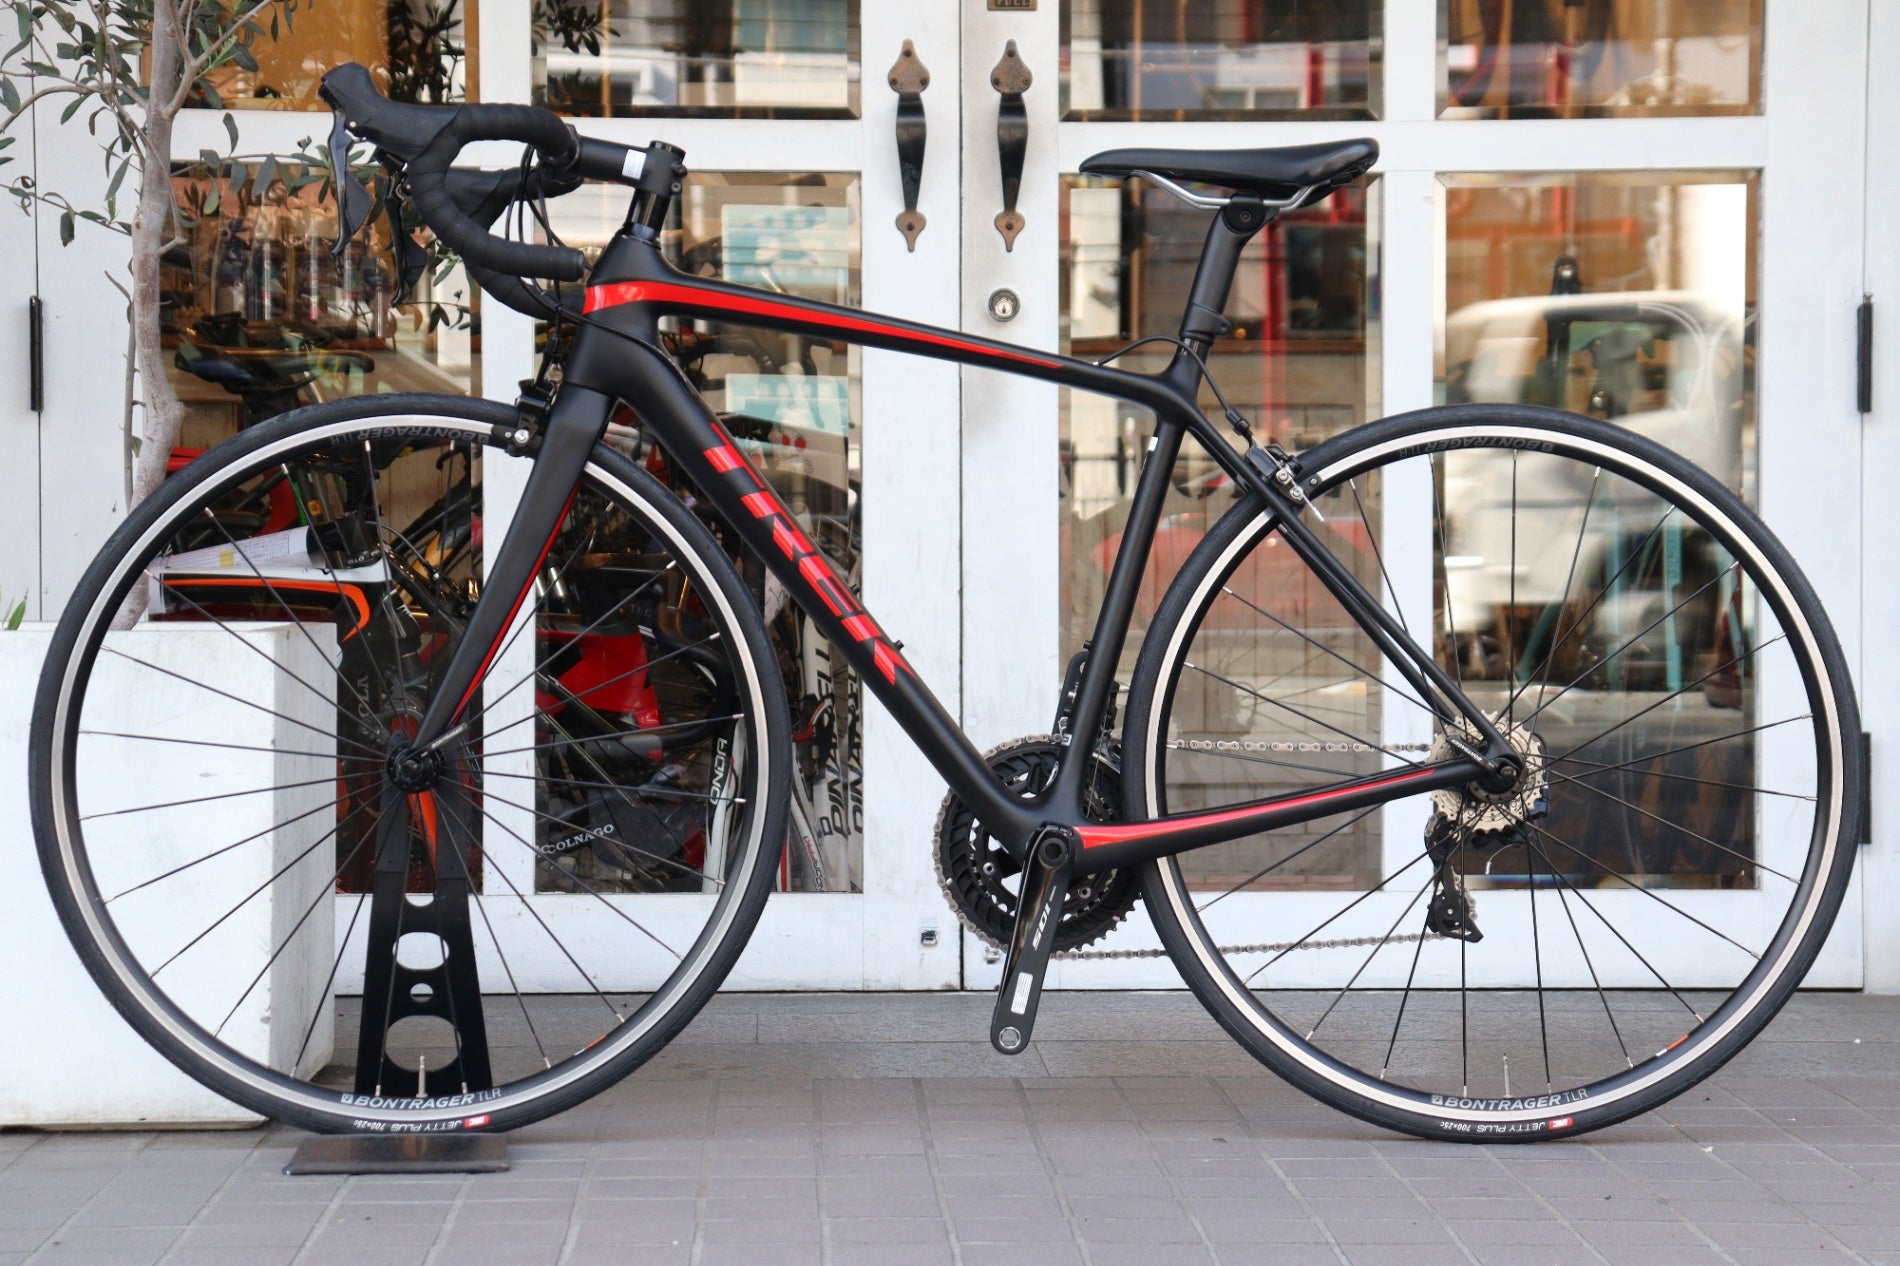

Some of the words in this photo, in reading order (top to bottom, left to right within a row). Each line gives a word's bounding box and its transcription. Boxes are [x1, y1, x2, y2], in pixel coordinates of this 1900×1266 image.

[357, 426, 478, 442] BONTRAGER
[1424, 436, 1542, 453] BONTRAGER
[703, 422, 917, 686] TREK
[710, 737, 728, 806] ONDA
[353, 1093, 475, 1111] BONTRAGER
[478, 1087, 502, 1102] TLR
[1444, 1094, 1562, 1111] BONTRAGER
[1566, 1087, 1589, 1103] TLR
[390, 1123, 422, 1133] PLUS
[424, 1119, 462, 1132] JETTY
[1476, 1124, 1507, 1133] PLUS
[1508, 1121, 1546, 1132] JETTY
